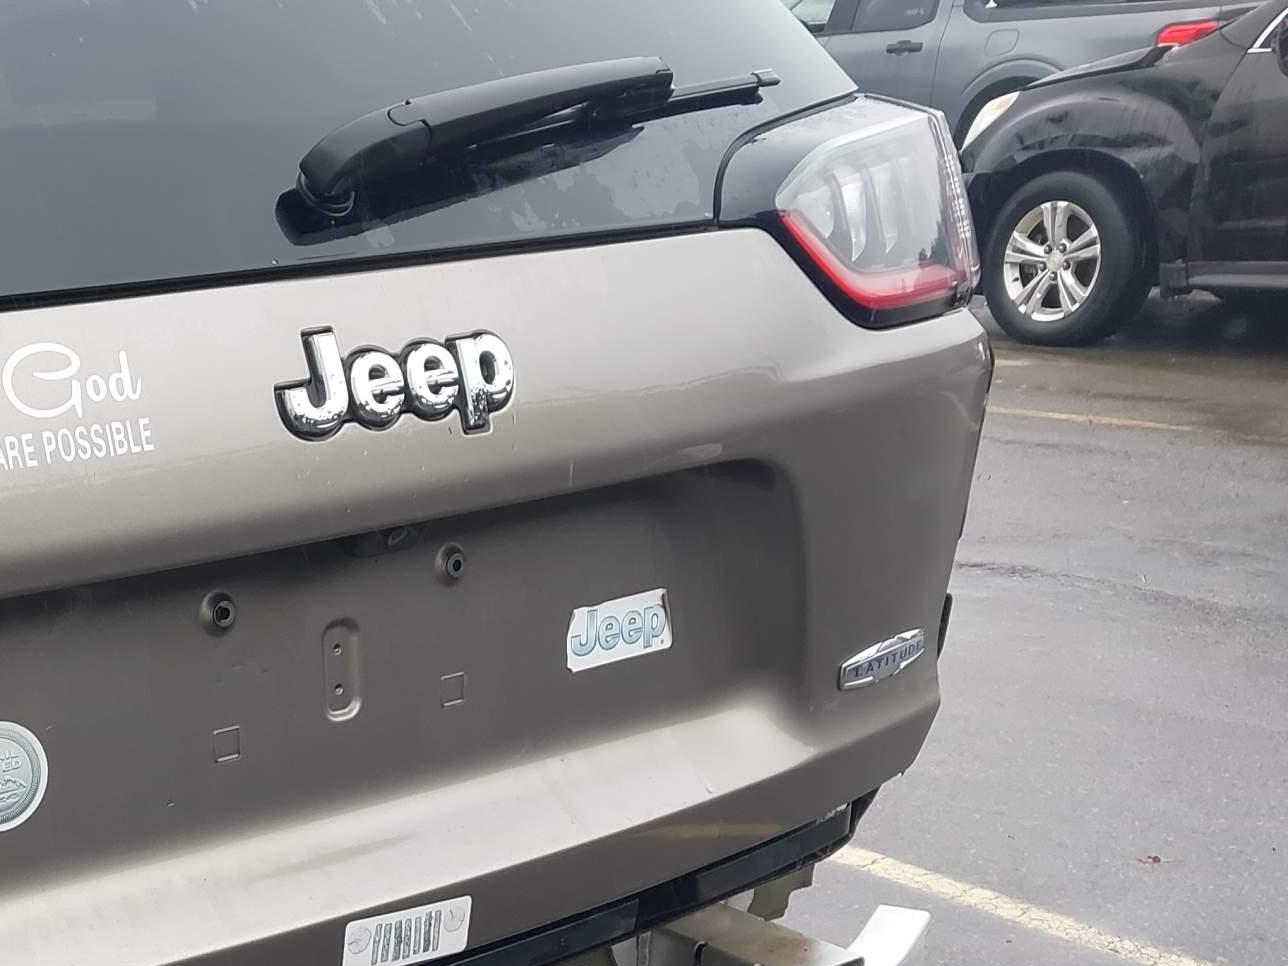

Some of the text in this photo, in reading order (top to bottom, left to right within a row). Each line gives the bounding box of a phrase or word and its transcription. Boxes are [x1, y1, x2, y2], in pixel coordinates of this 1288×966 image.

[2, 342, 142, 418] God
[273, 325, 514, 442] Jeep
[41, 417, 155, 465] POSSIBLE
[571, 603, 666, 656] Jeep
[854, 640, 921, 678] LATITUDE
